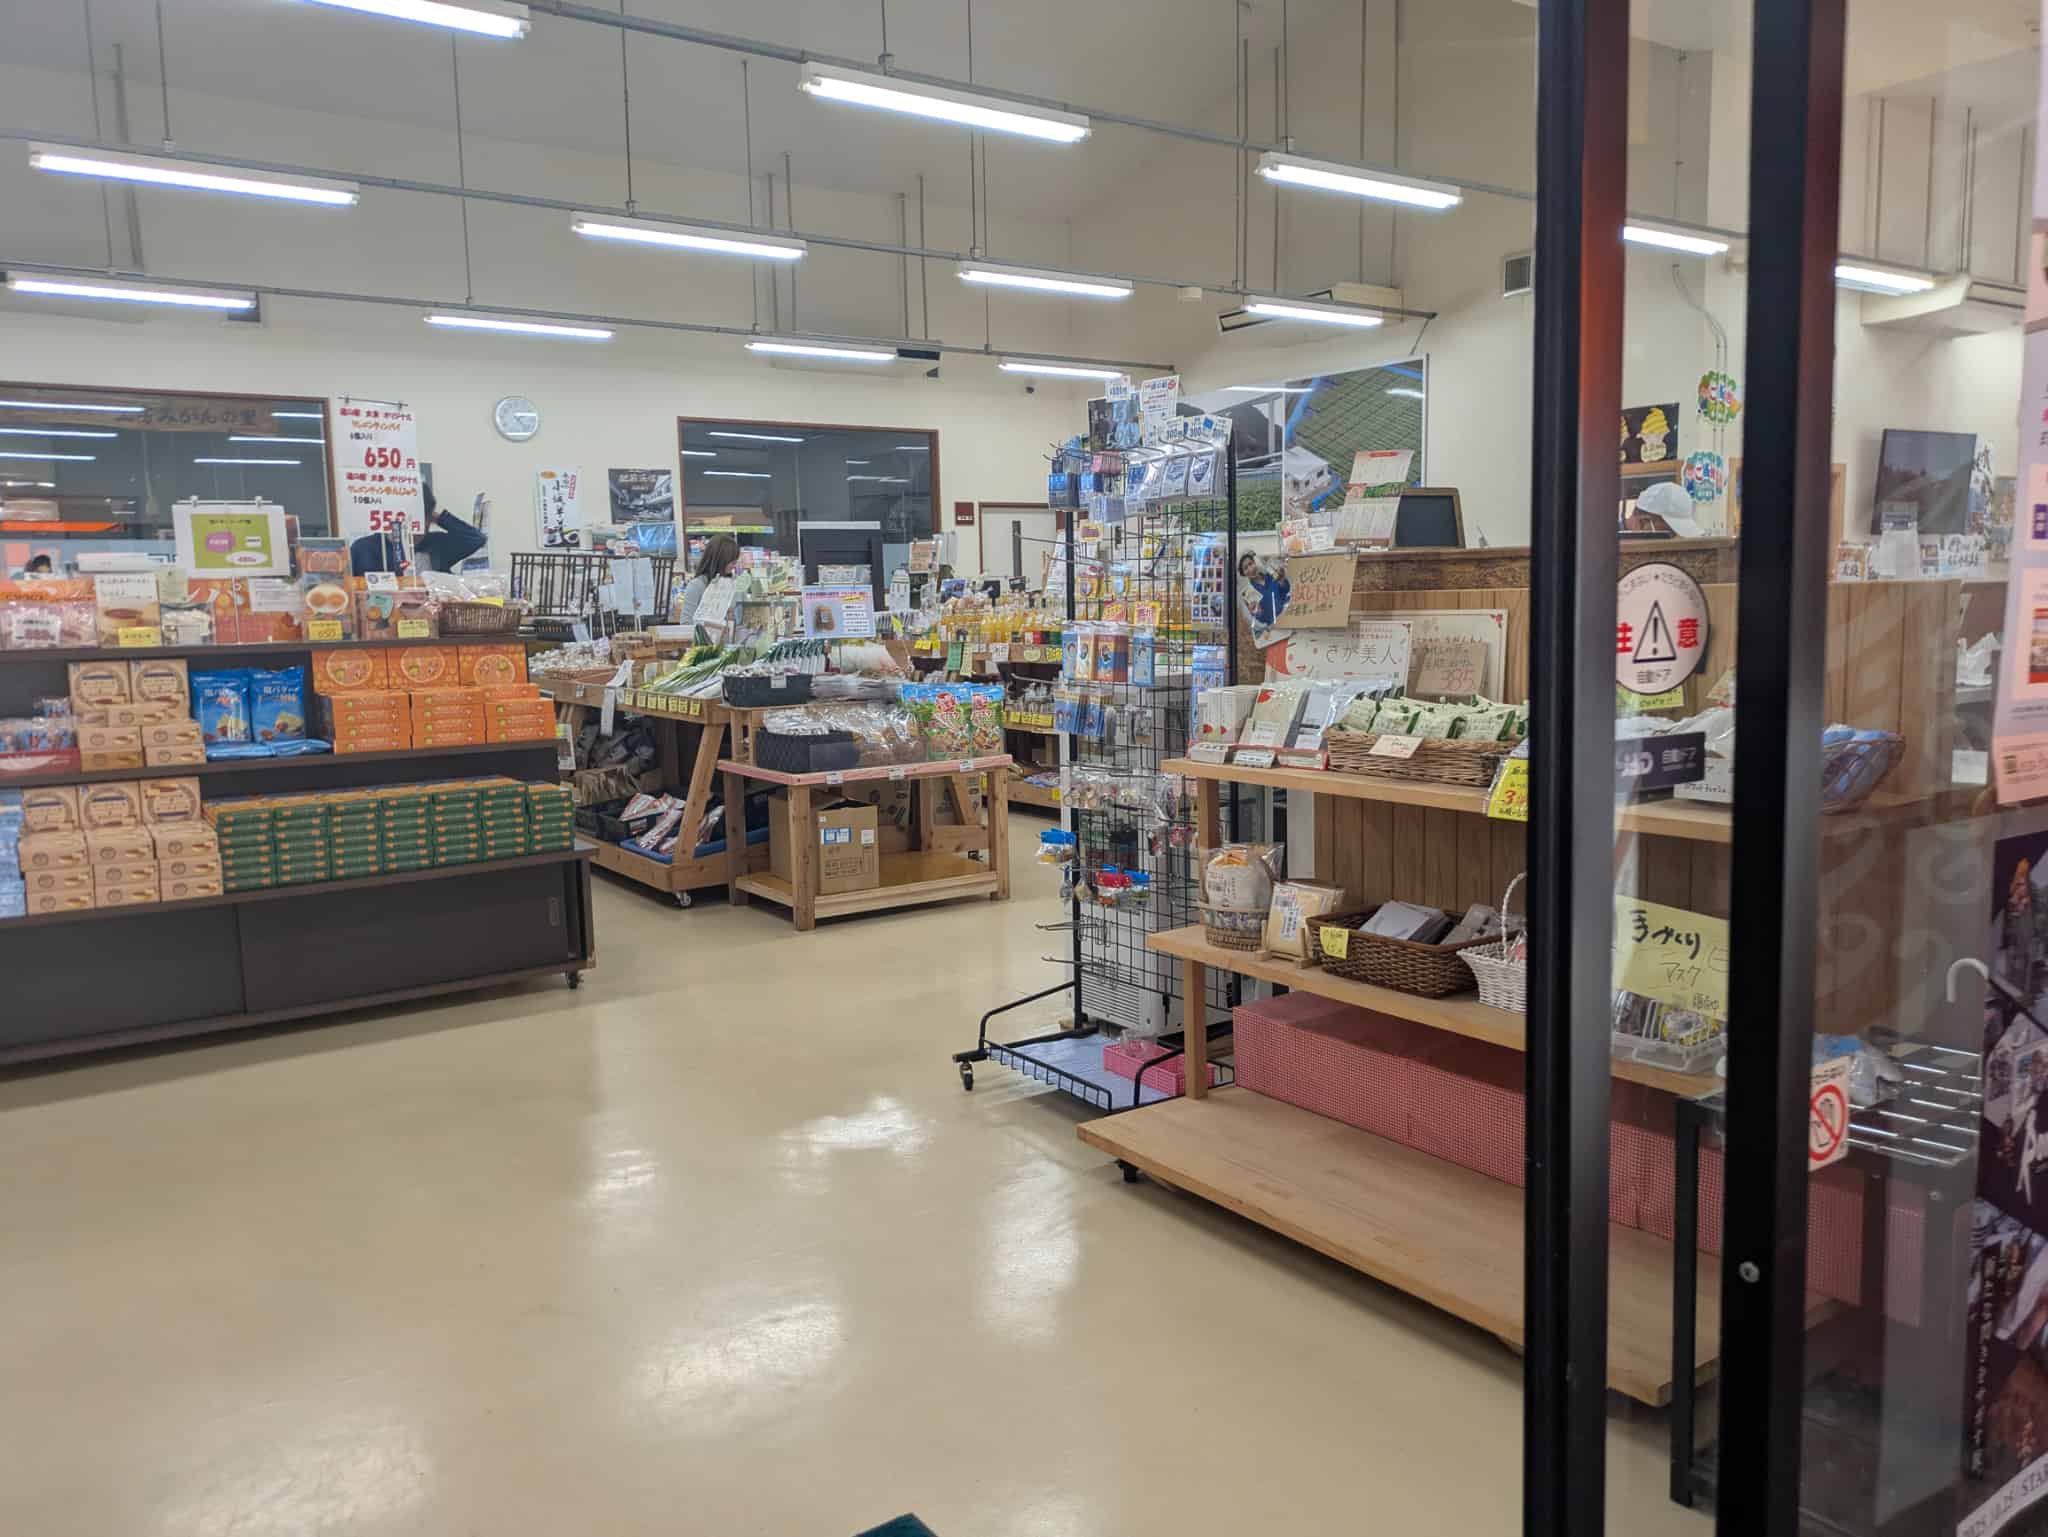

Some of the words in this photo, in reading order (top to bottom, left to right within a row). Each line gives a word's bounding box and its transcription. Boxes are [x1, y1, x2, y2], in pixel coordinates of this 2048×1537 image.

[364, 446, 402, 469] 650
[1677, 618, 1699, 649] 意
[1326, 641, 1399, 666] さが美人
[1630, 908, 1701, 961] 手づくり
